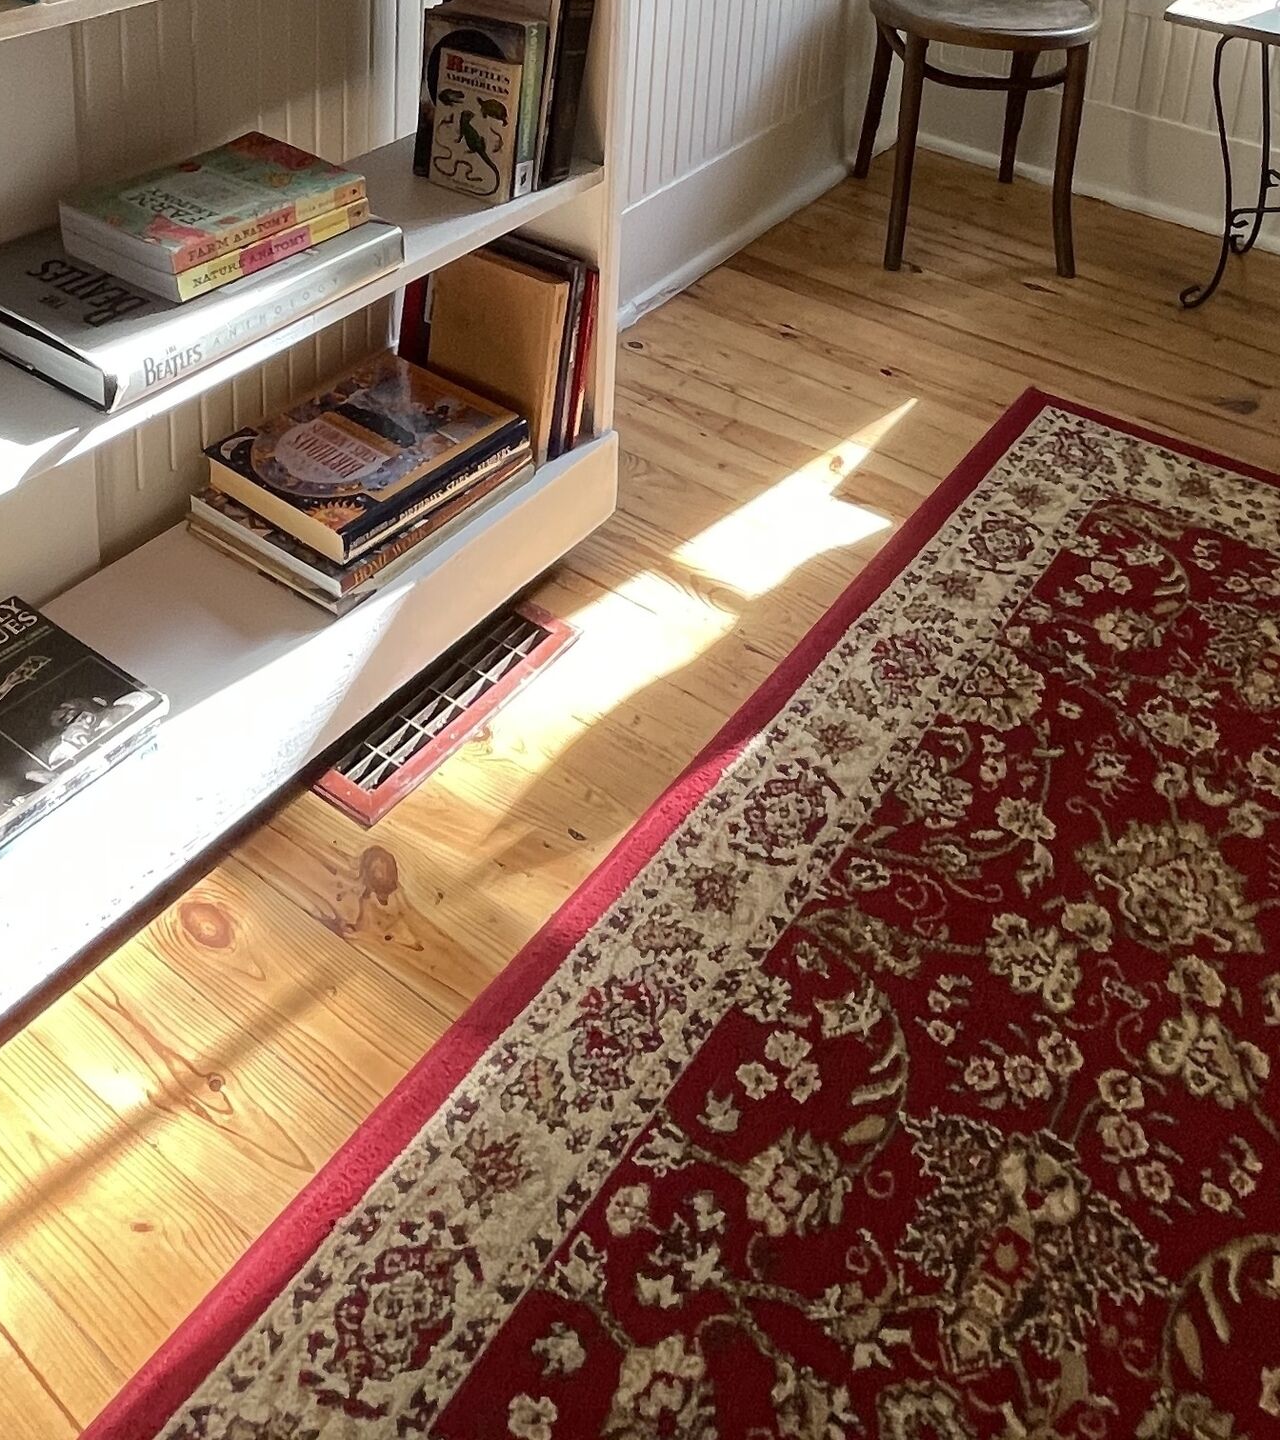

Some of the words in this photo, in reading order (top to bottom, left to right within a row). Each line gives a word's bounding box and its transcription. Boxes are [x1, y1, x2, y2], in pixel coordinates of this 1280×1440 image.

[447, 53, 511, 86] REPTILES
[187, 235, 232, 262] FARM
[233, 210, 292, 244] ANATOMY
[192, 260, 244, 289] NATURE
[248, 234, 307, 264] ANATOMY
[26, 259, 151, 328] BEATLES
[143, 342, 203, 388] BEATLES
